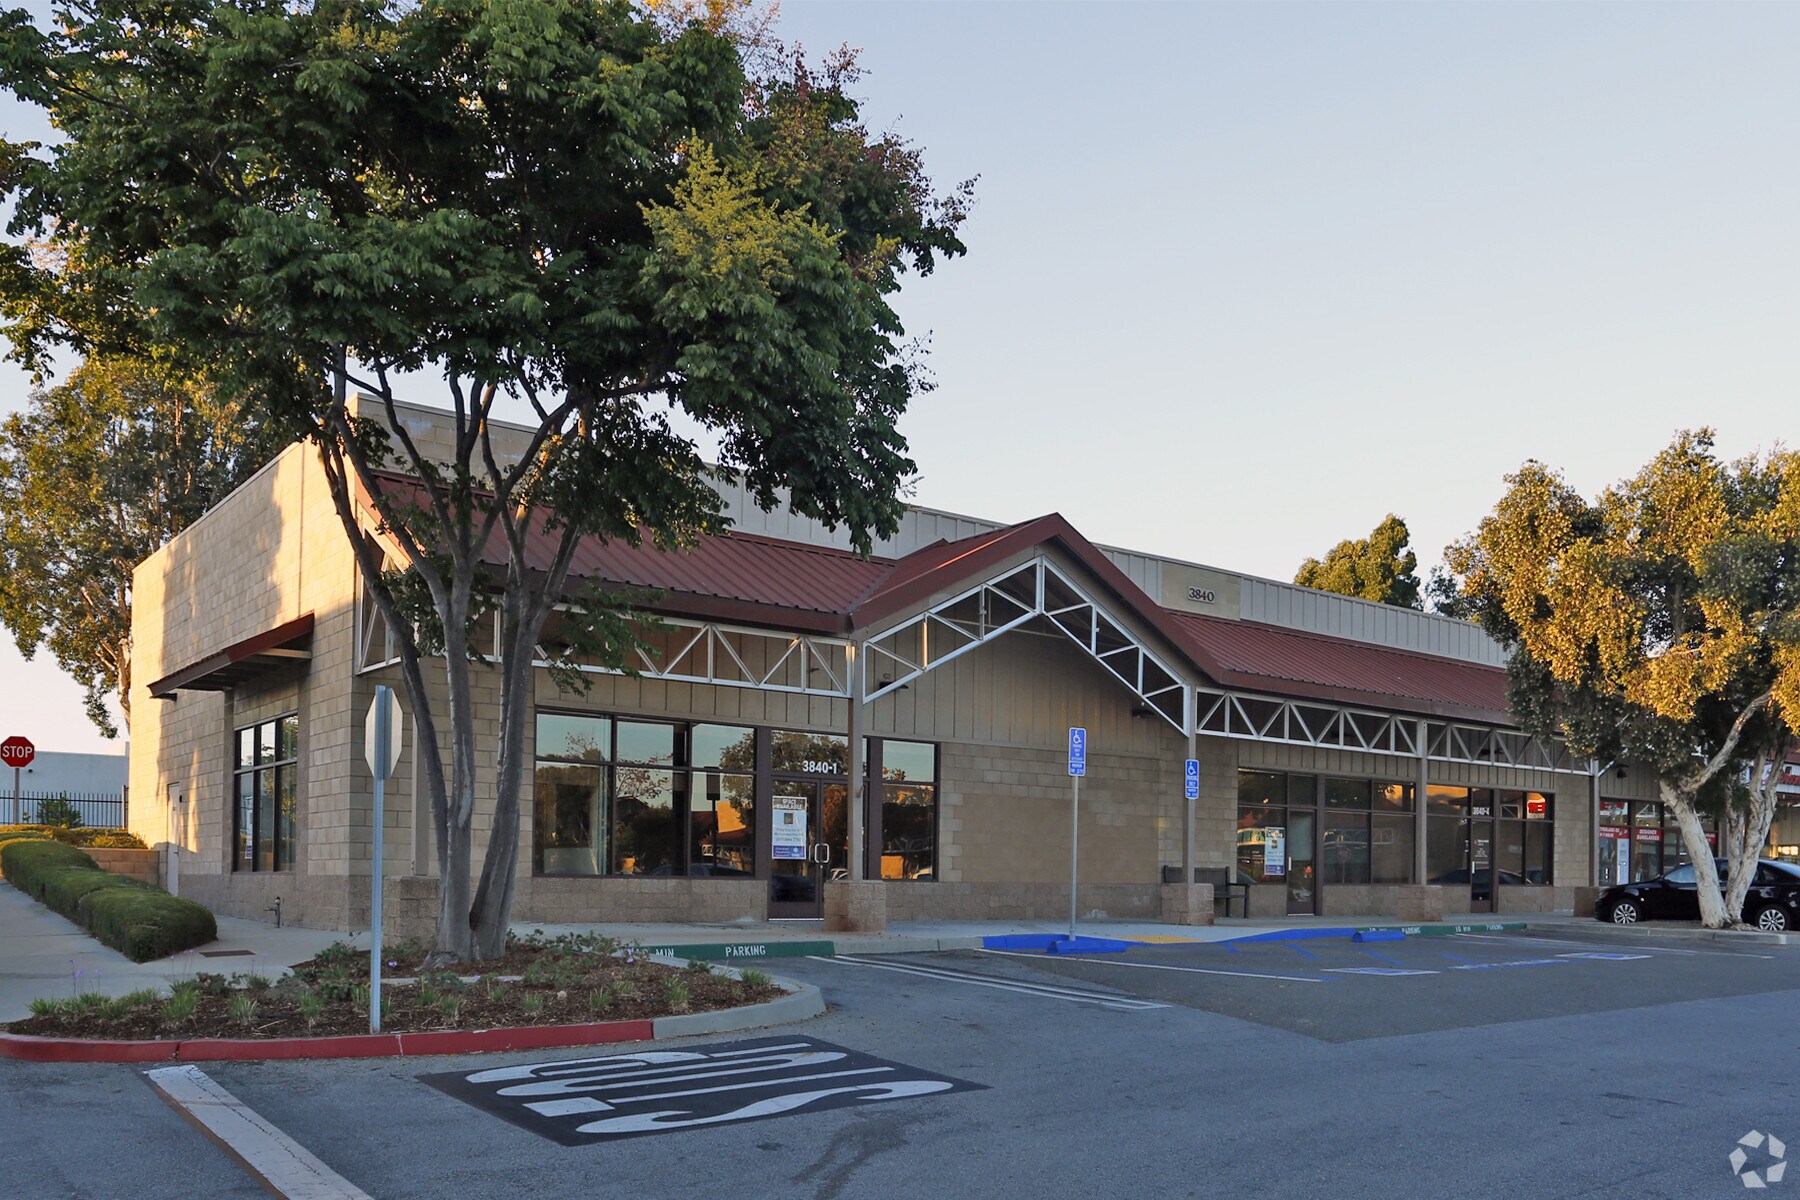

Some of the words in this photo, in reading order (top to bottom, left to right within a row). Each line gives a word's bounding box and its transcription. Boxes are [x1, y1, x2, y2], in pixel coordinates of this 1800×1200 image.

[1188, 587, 1215, 602] 3840
[2, 745, 33, 758] STOP
[802, 760, 838, 774] 3840-1
[655, 948, 675, 958] MIN
[725, 945, 766, 957] PARKING
[465, 1043, 954, 1134] STOP
